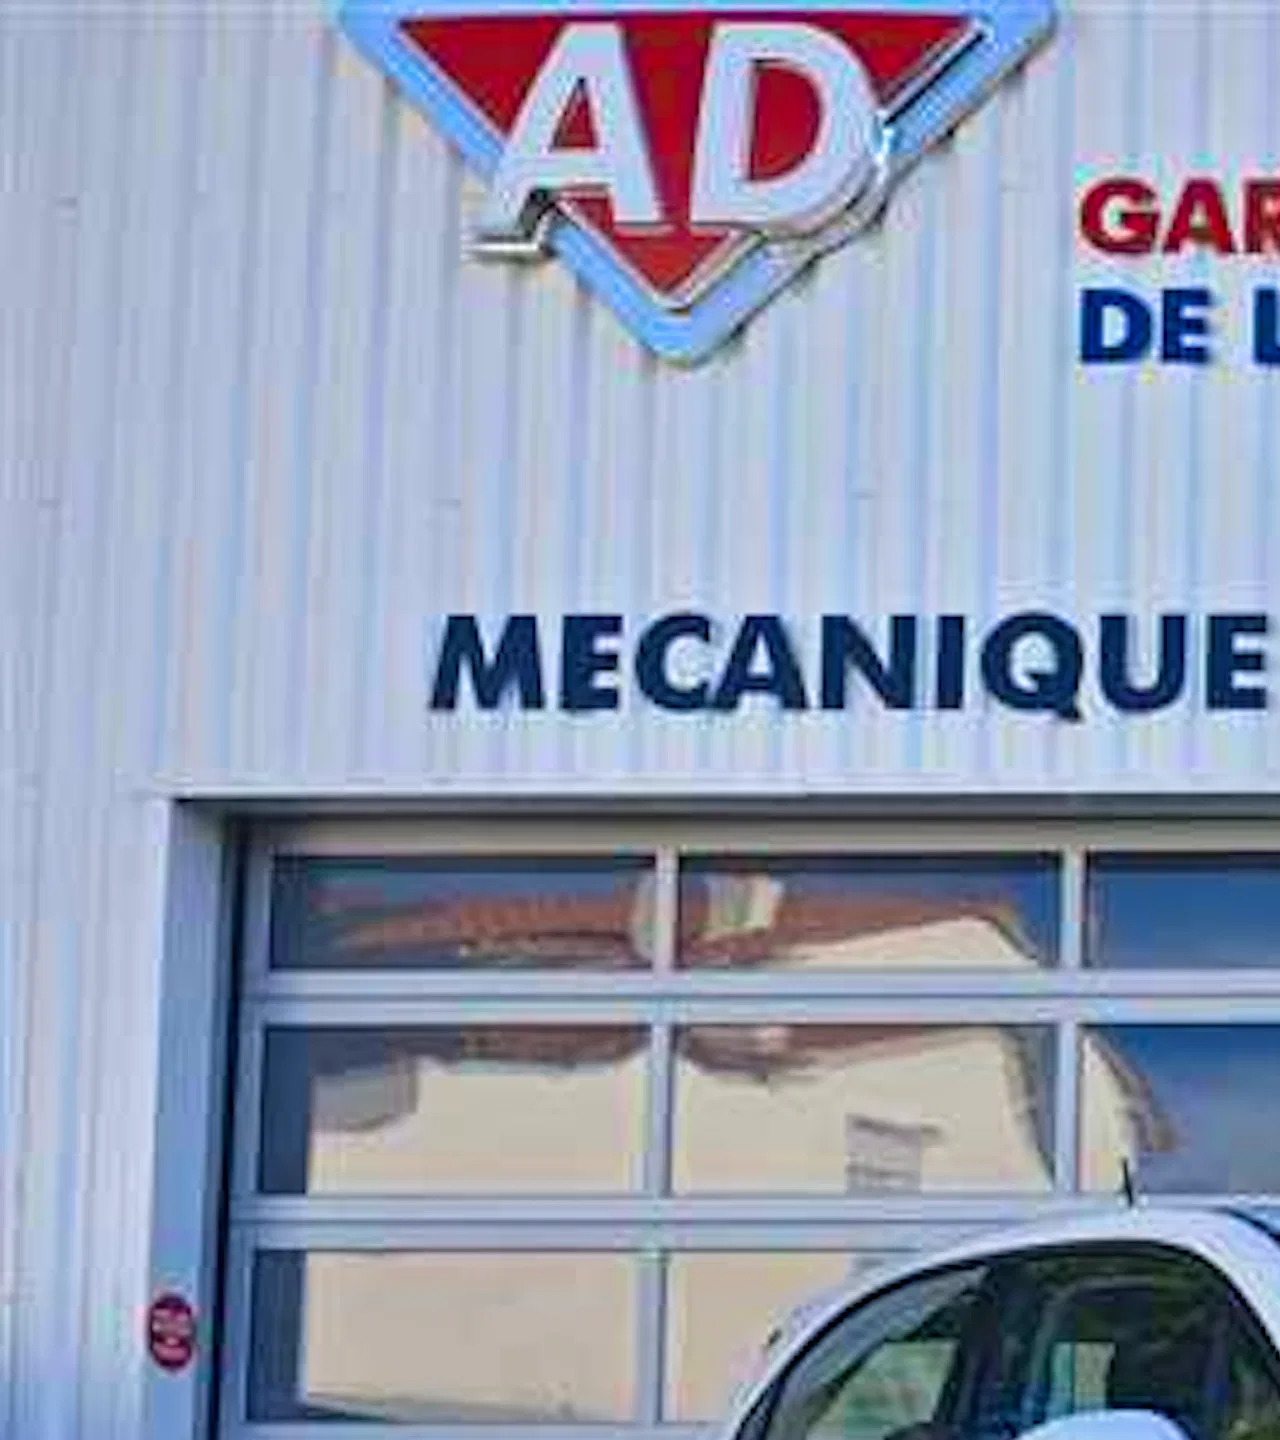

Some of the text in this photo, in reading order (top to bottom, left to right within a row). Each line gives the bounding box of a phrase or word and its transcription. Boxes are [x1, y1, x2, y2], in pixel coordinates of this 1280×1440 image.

[468, 20, 888, 240] AD
[1079, 287, 1212, 364] DE
[428, 610, 1271, 721] MECANIQUE
